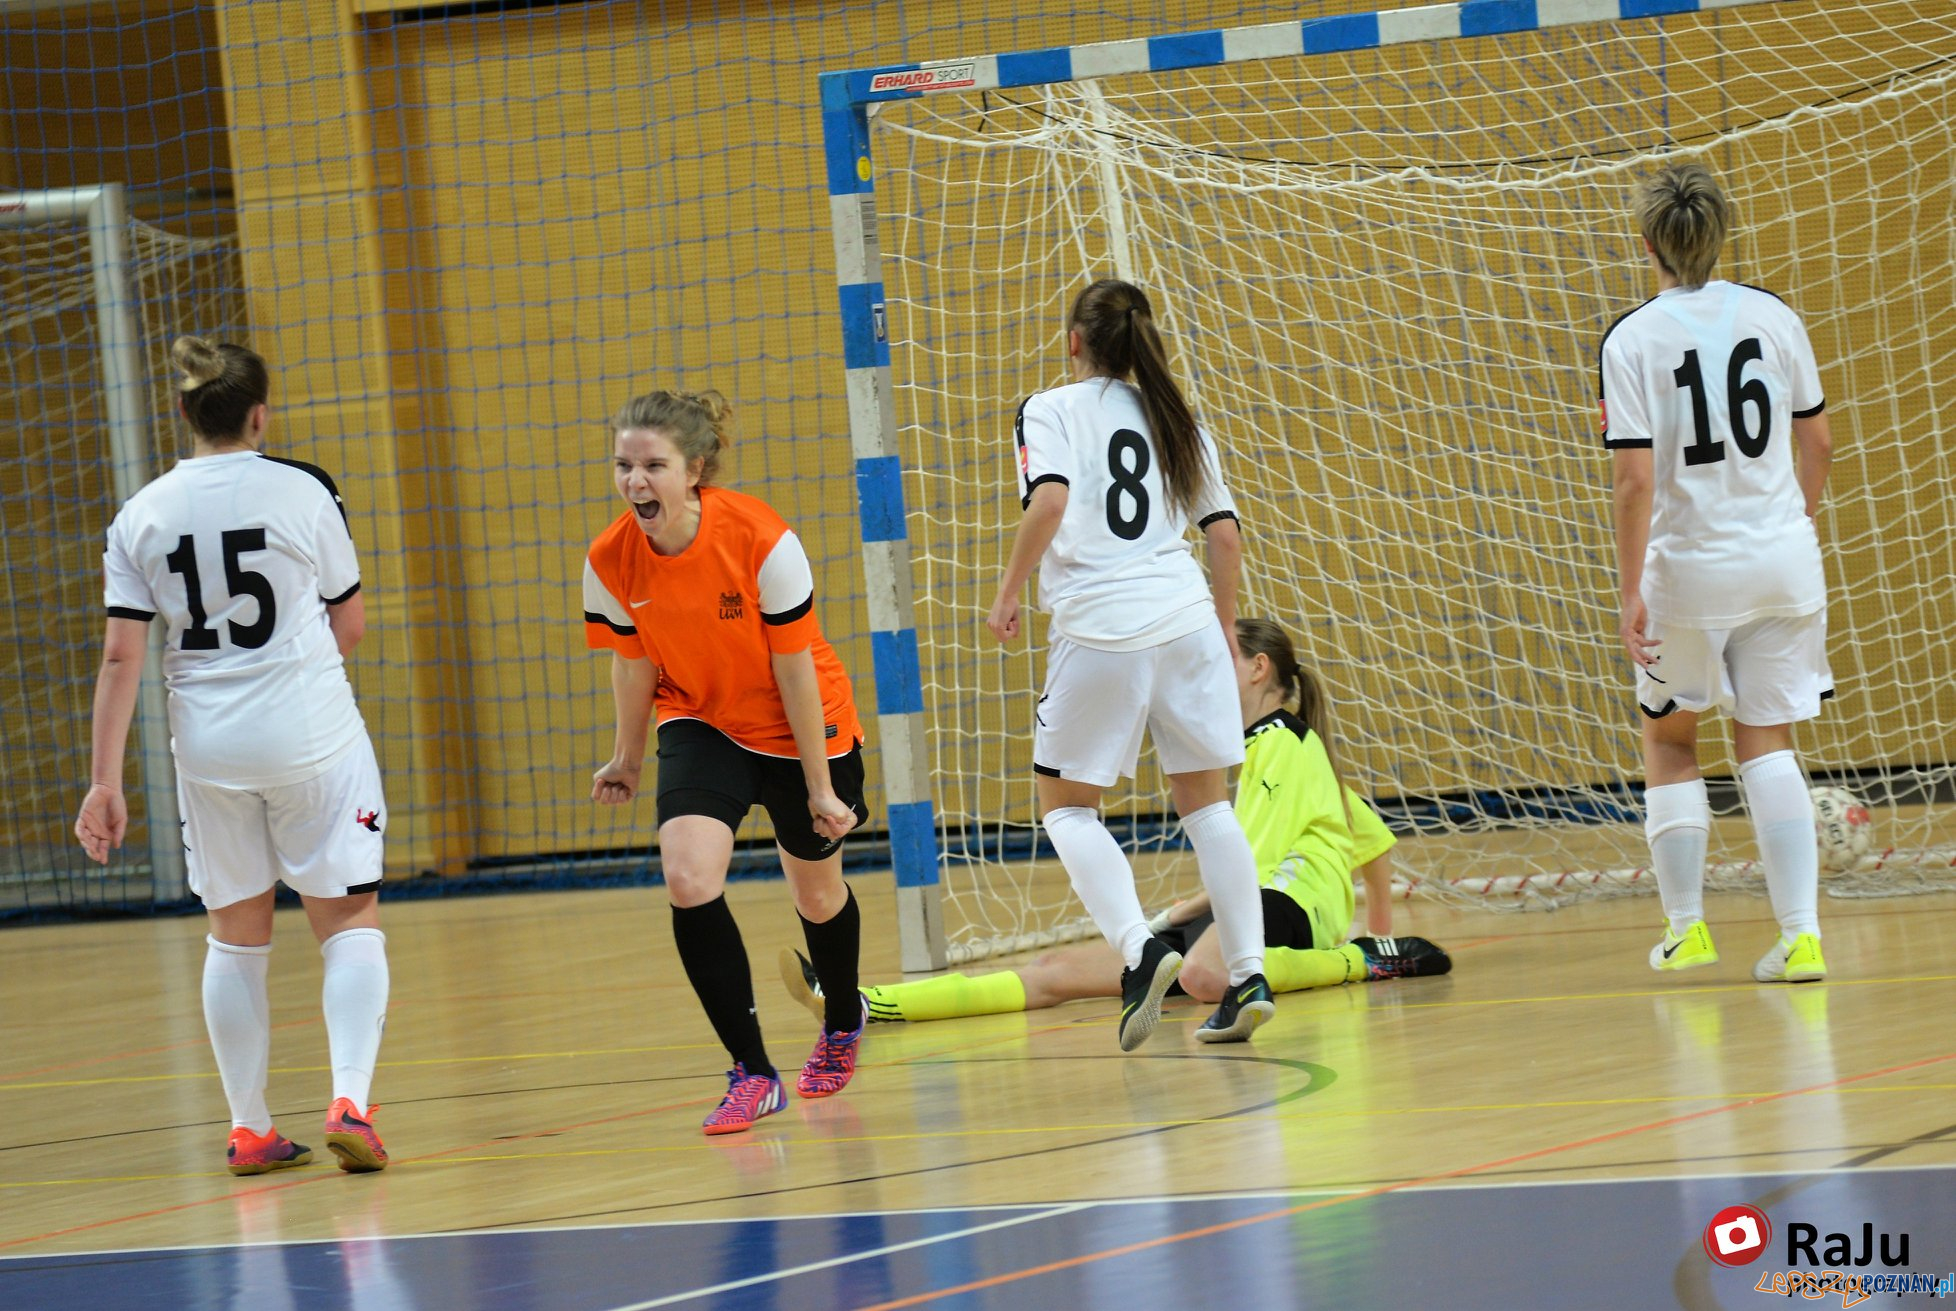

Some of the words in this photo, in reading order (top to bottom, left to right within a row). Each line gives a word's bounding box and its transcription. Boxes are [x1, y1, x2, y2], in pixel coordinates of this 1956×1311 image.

[874, 72, 933, 89] ERHARD
[938, 68, 969, 82] SPORT
[1673, 338, 1771, 466] 16
[1107, 428, 1150, 540] 8
[167, 528, 276, 650] 15
